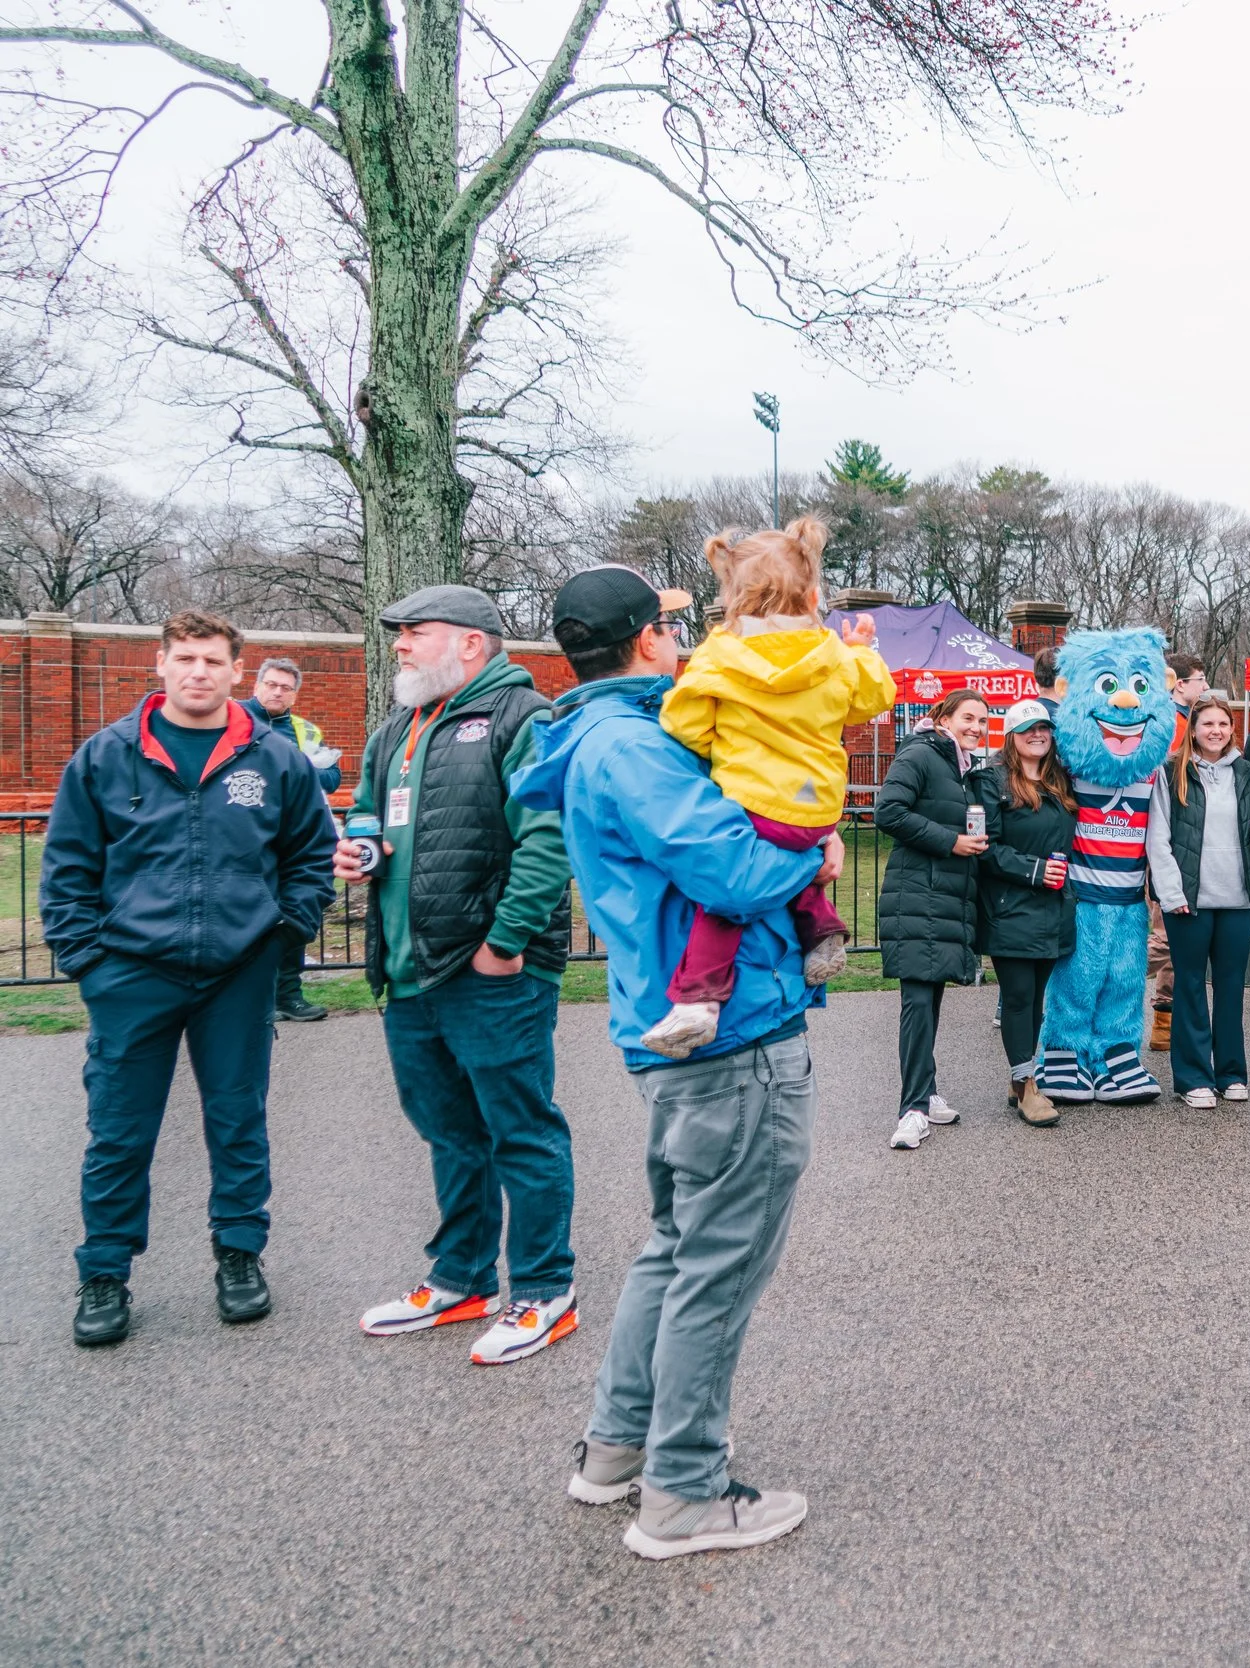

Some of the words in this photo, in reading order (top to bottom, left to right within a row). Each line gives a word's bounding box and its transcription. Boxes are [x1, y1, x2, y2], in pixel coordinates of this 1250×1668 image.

[947, 633, 993, 648] SILVER
[965, 674, 1039, 700] FREEJA
[1105, 815, 1129, 827] Alloy
[1083, 823, 1143, 837] Therapeutics
